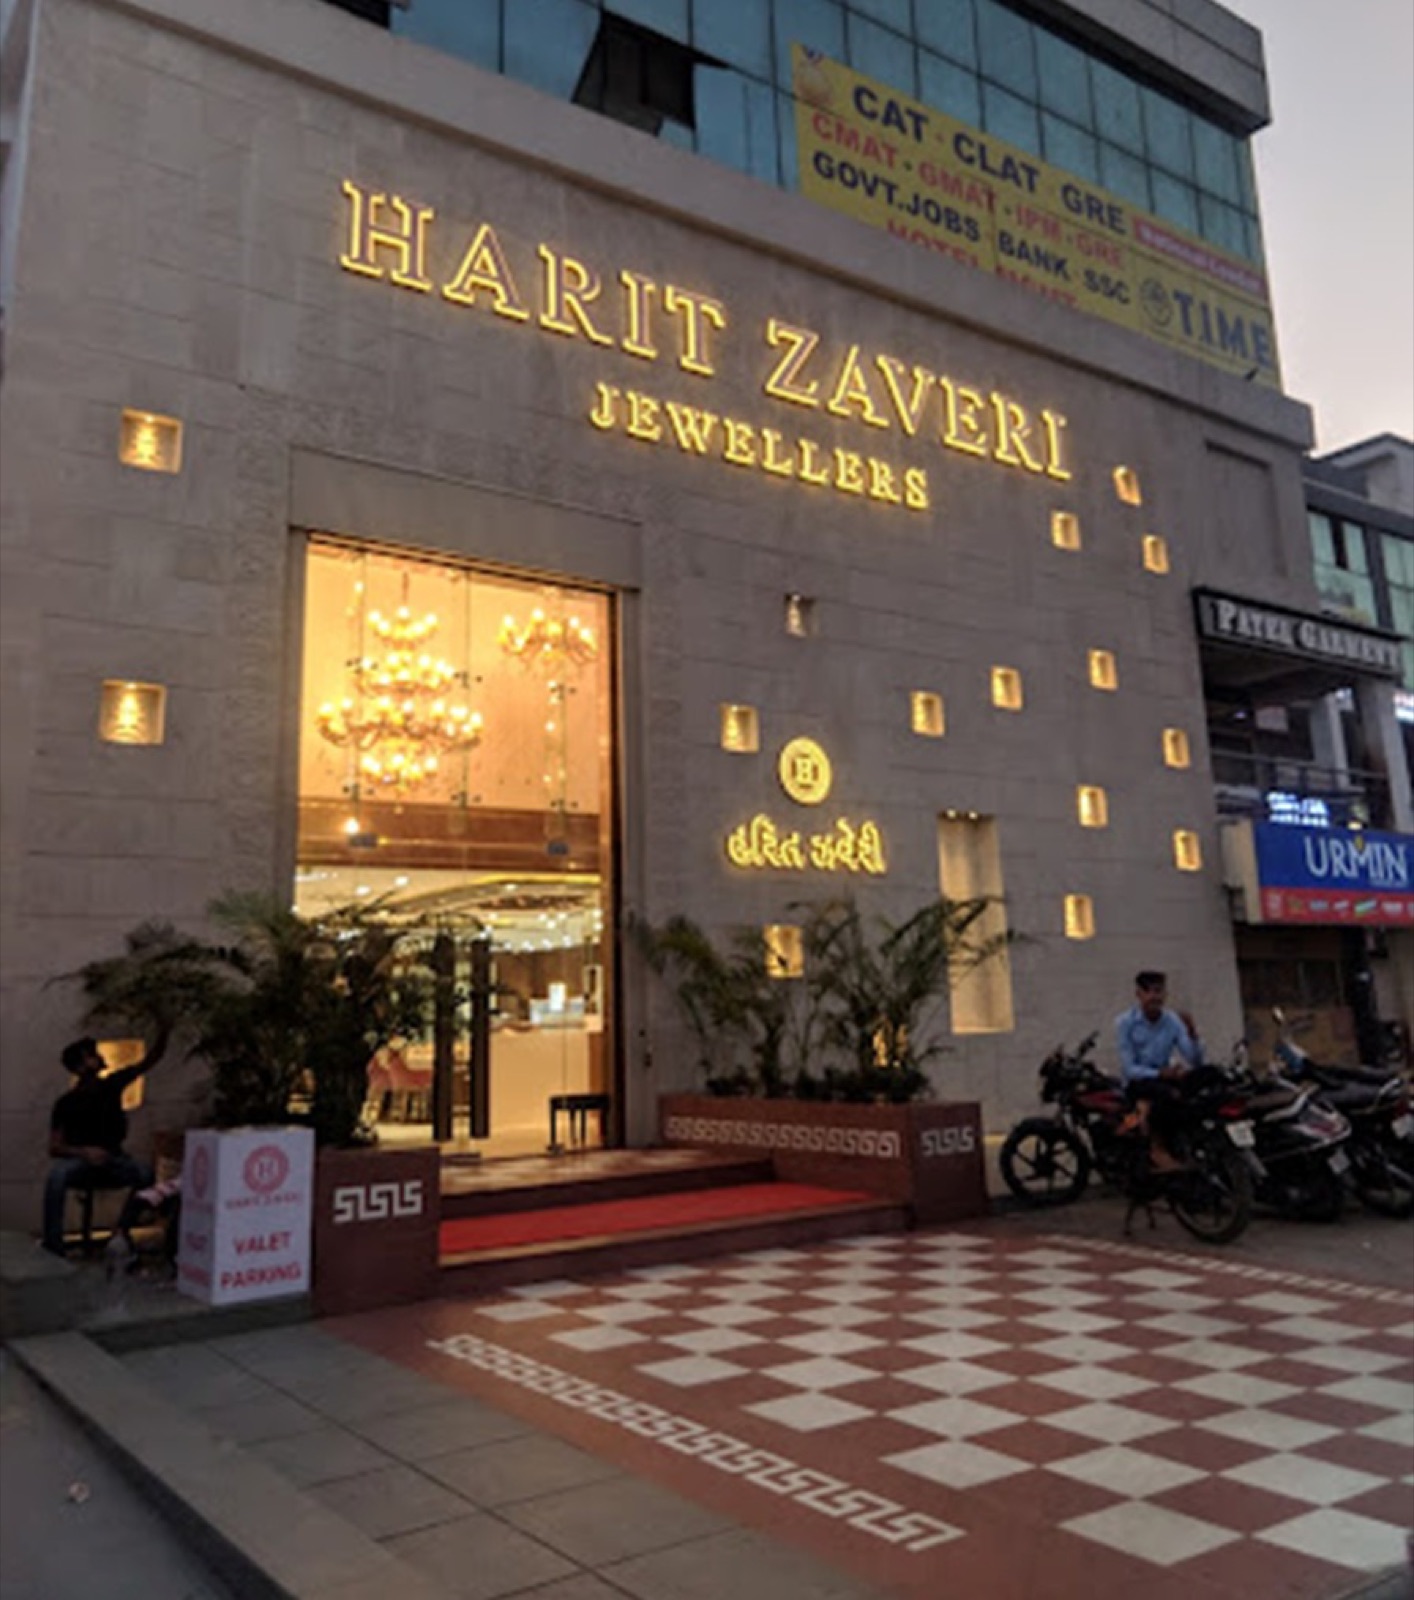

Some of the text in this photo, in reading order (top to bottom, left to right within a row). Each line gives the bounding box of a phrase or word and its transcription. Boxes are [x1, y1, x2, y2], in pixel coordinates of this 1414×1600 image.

[812, 111, 899, 169] CMAT
[918, 161, 997, 214] GMAT
[853, 85, 1127, 235] CAT CLAT GRE
[998, 229, 1070, 281] BANK
[1083, 267, 1130, 305] SSC
[339, 180, 1073, 480] HARIT ZAVERI
[1173, 288, 1271, 367] TIME
[590, 383, 930, 510] JEWELLERS
[727, 813, 805, 868] હરિત
[1303, 835, 1408, 880] URMIN
[219, 1261, 302, 1290] PARKING
[233, 1230, 292, 1255] VALET
